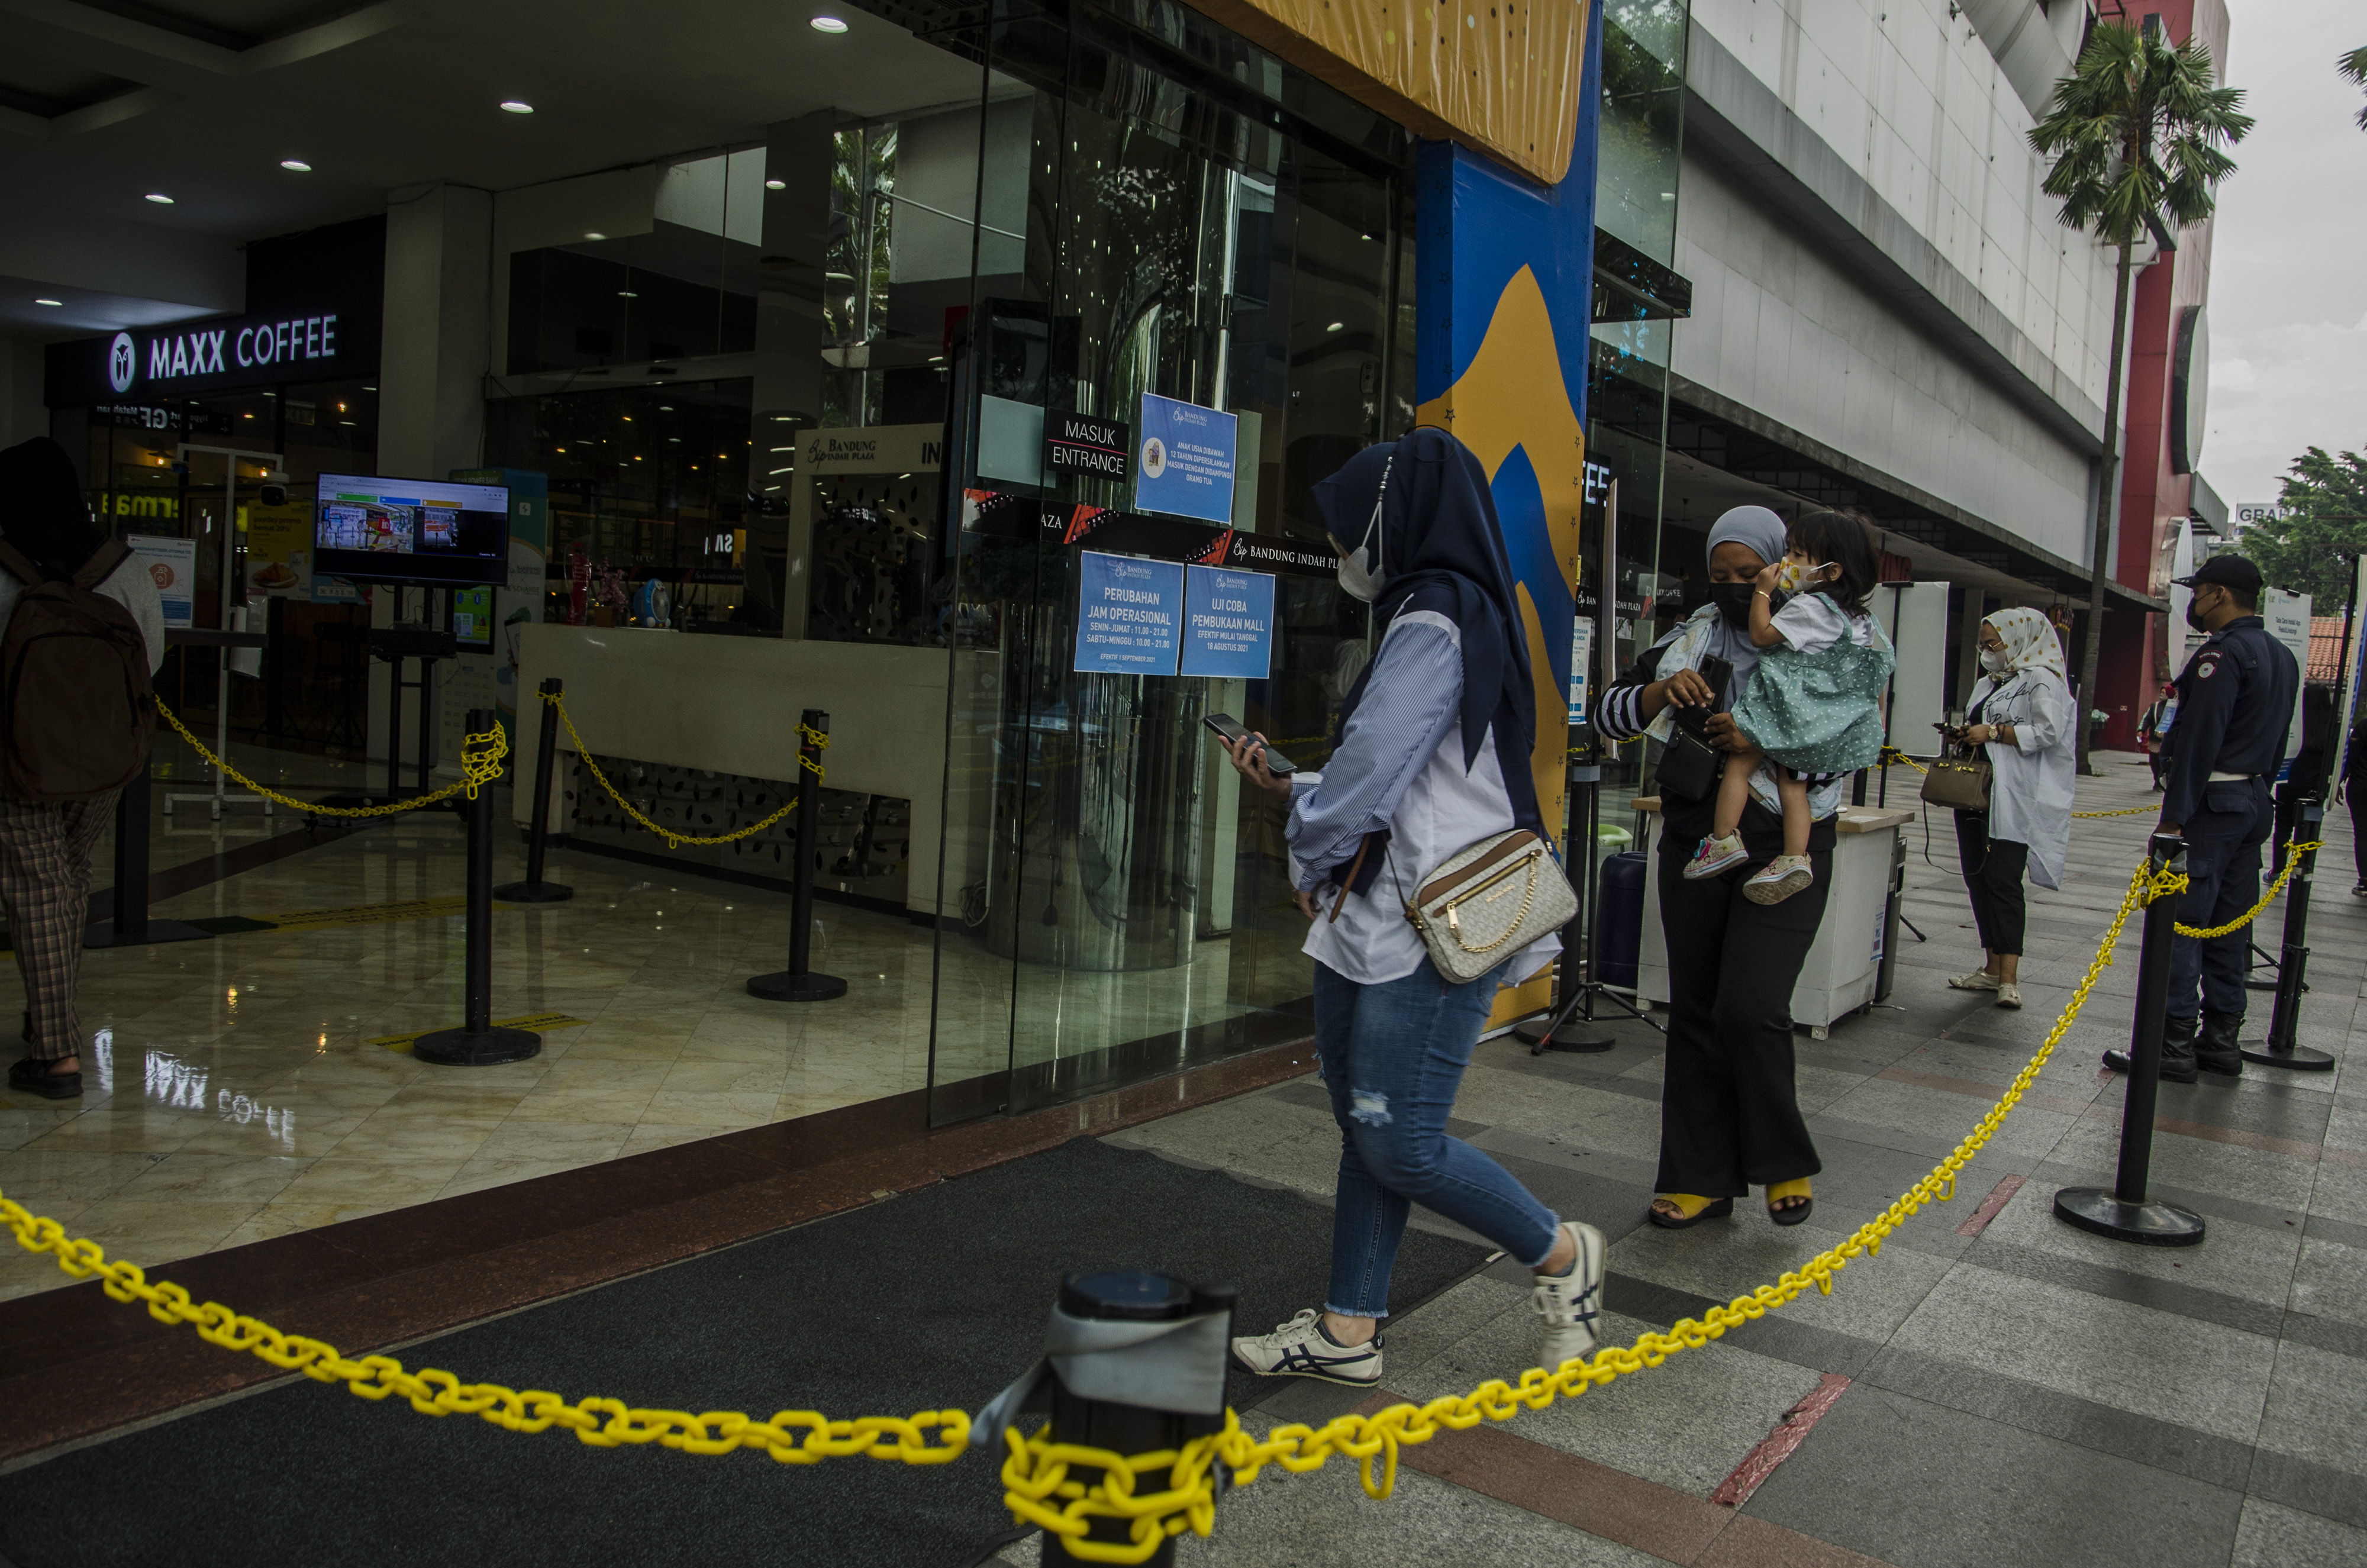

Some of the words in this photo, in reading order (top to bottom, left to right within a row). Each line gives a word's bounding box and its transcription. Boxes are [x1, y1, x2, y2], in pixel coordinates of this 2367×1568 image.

[148, 330, 227, 380] MAXX
[237, 314, 337, 367] COFFEE
[1185, 411, 1207, 422] BANDUNG
[1066, 420, 1115, 446] MASUK
[829, 439, 876, 451] BANDUNG
[1178, 441, 1191, 450] ANAK
[1191, 444, 1202, 453] USIA
[1203, 447, 1224, 458] DIBAWAH
[1053, 446, 1124, 474] ENTRANCE
[1178, 451, 1192, 462] TAHUN
[1194, 454, 1230, 469] DIPERSILAHKAN
[1167, 460, 1184, 470] MASUK
[1185, 463, 1204, 473] DENGAN
[1205, 467, 1231, 479] DIDAMPINGI
[1186, 474, 1202, 483] ORANG
[1203, 477, 1212, 485] TUA
[1250, 546, 1295, 563] BANDUNG
[1298, 553, 1326, 567] INDAH
[1127, 566, 1152, 575] BANDUNG
[1227, 577, 1247, 585] BANDUNG
[1104, 587, 1160, 605] PERUBAHAN
[1212, 598, 1224, 611] UJI
[1226, 599, 1247, 613] COBA
[1615, 600, 1627, 609] NDAH
[1628, 602, 1641, 611] PLAZA
[1088, 605, 1107, 620] JAM
[1110, 607, 1171, 625] OPERASIONAL
[1192, 614, 1242, 630] PEMBUKAAN
[1244, 618, 1264, 631] MALL
[1090, 622, 1130, 634] SENIN-JUMAT
[1134, 626, 1149, 634] 11.00
[1153, 628, 1168, 637] 21.00
[1198, 630, 1219, 638] EFEKTIF
[1220, 632, 1235, 640] MULAI
[1236, 633, 1258, 642] TANGGAL
[1086, 634, 1131, 646] SABTU-MINGGU
[1136, 638, 1150, 647] 10.00
[1155, 640, 1170, 649] 21.00
[1214, 643, 1237, 651] AGUSTUS
